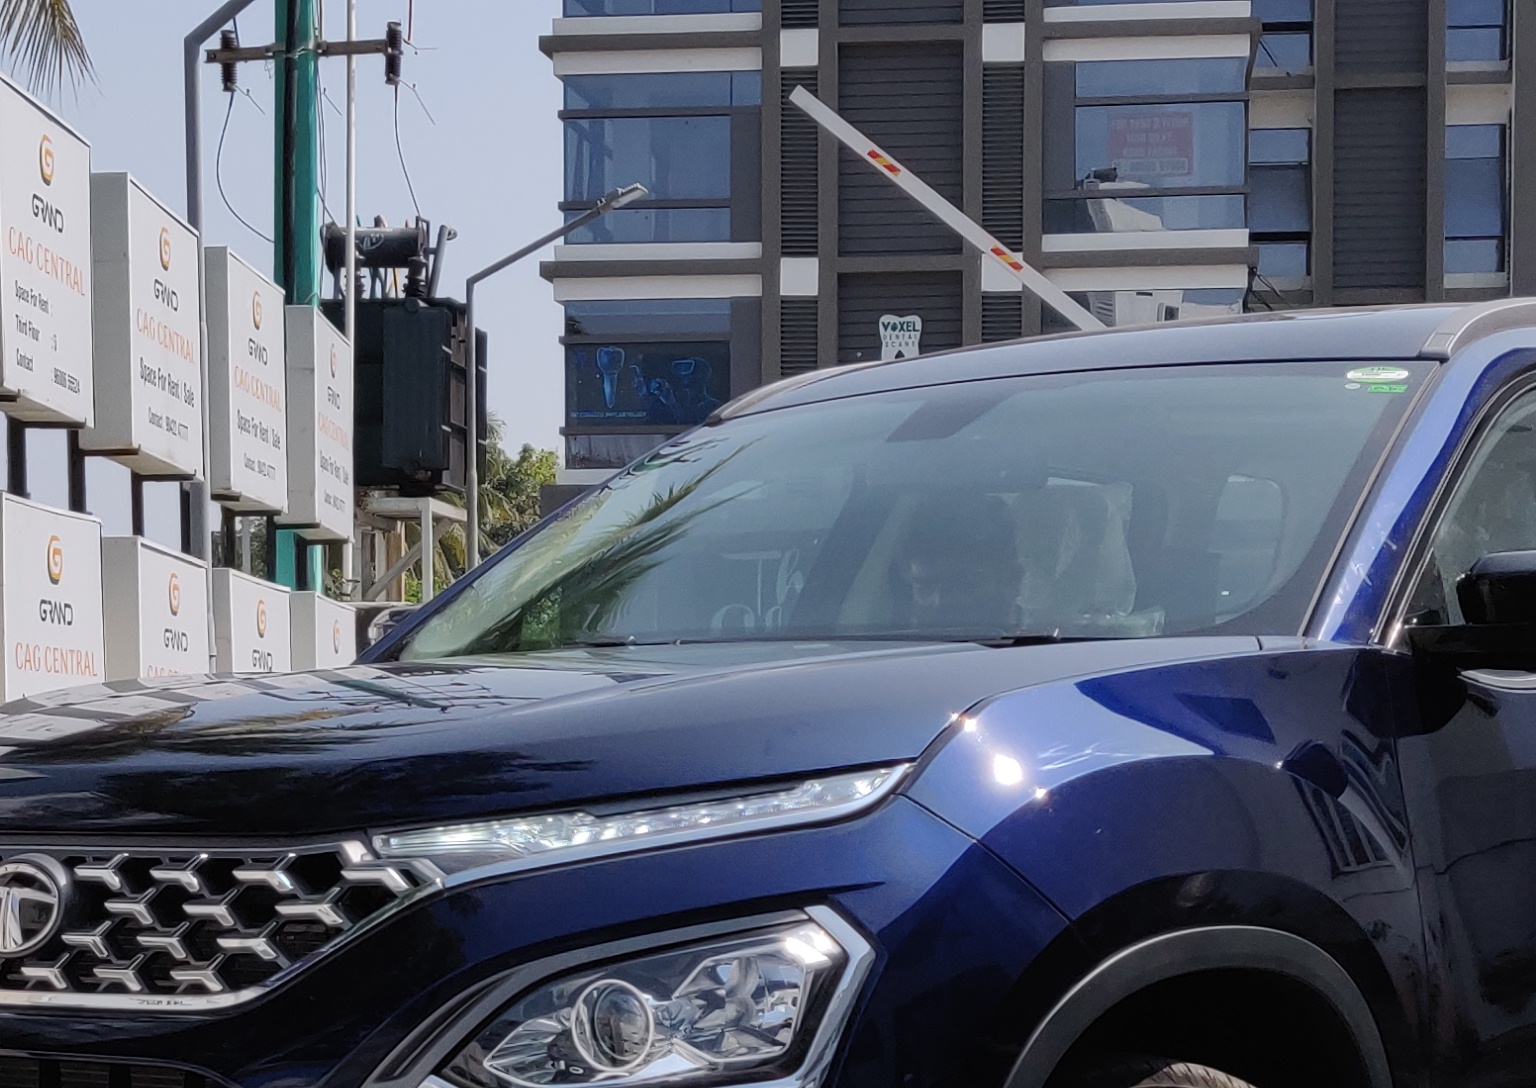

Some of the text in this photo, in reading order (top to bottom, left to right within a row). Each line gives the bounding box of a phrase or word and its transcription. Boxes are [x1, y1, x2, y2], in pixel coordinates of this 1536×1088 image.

[32, 193, 64, 233] GRAND
[9, 226, 85, 296] CAG CENTRAL
[153, 278, 179, 312] GRAND
[137, 308, 196, 364] CAG CENTRAL
[881, 321, 920, 332] VOXEL
[139, 356, 156, 387] Space
[157, 367, 167, 392] For
[183, 382, 195, 408] Sale
[39, 599, 73, 626] GRAND
[163, 628, 188, 652] GRAND
[15, 642, 97, 677] CAG CENTRAL
